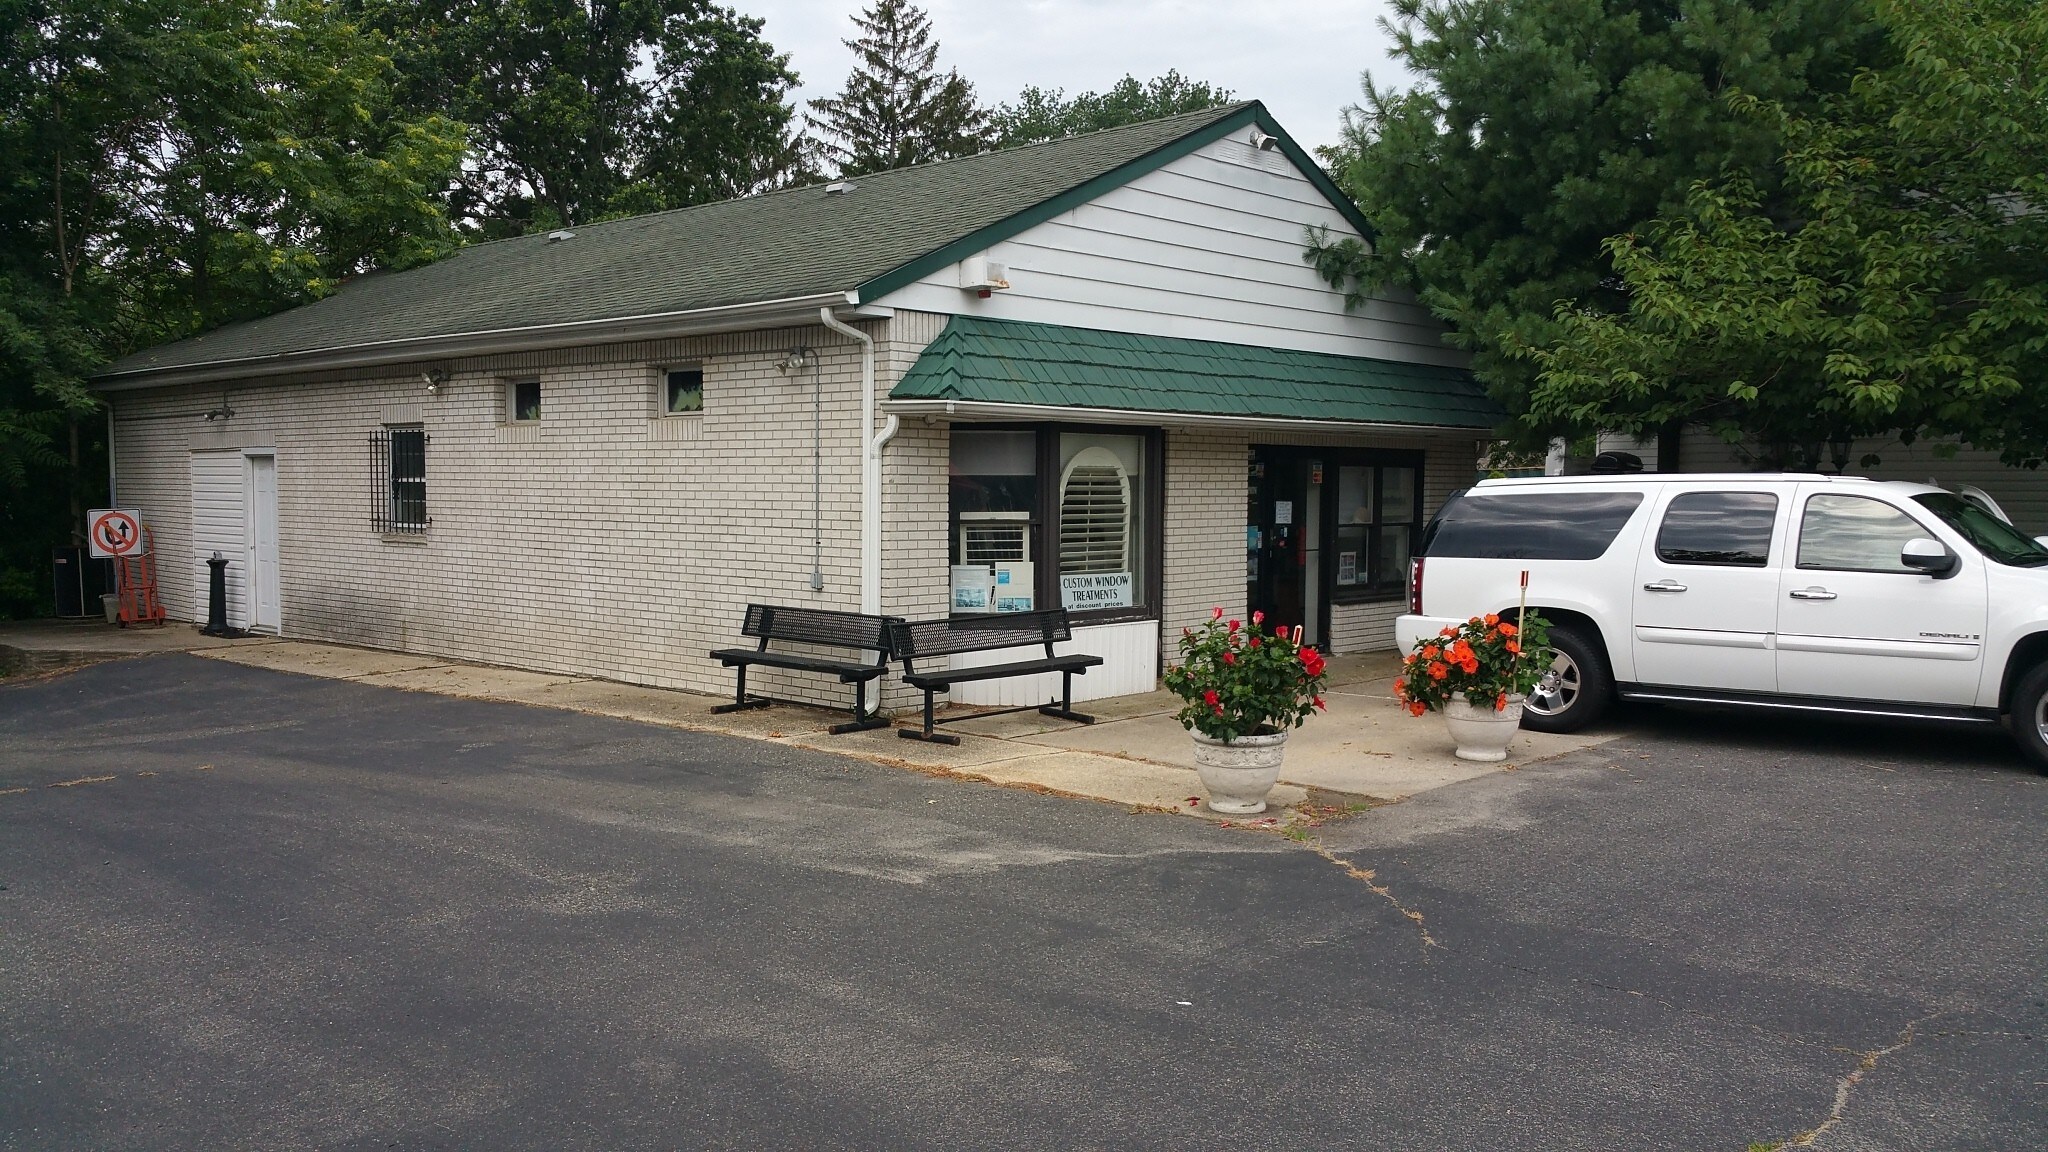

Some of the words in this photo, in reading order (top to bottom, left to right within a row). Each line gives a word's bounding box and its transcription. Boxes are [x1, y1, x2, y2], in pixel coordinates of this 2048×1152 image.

[1063, 577, 1093, 589] CUSTOM
[1095, 575, 1129, 587] WINDOW
[1072, 589, 1118, 601] TREATMENTS
